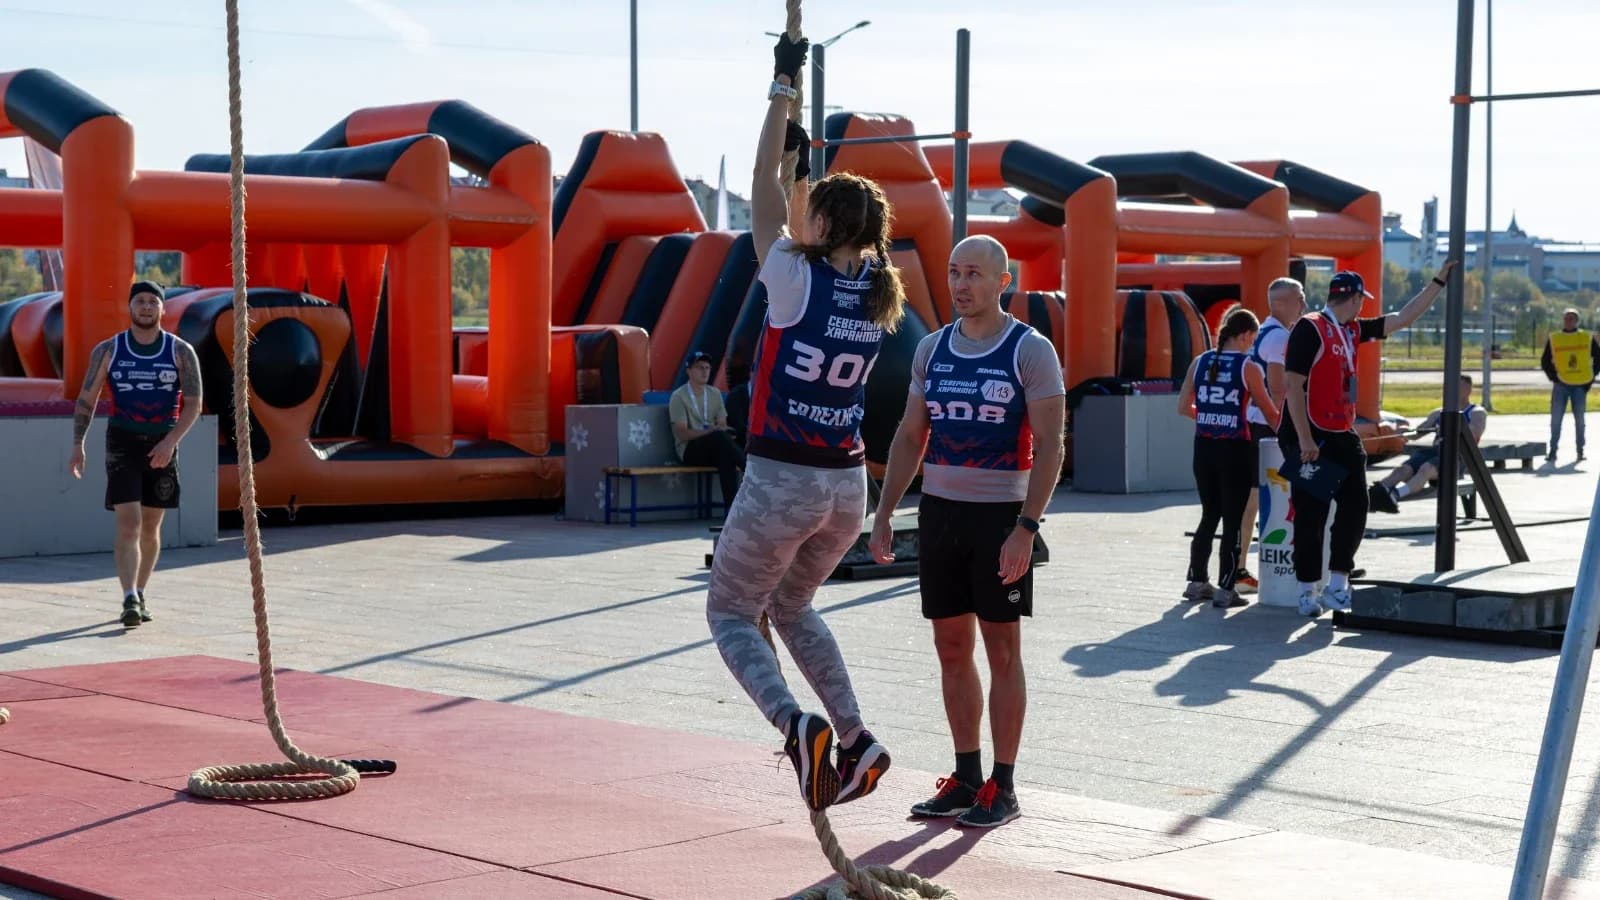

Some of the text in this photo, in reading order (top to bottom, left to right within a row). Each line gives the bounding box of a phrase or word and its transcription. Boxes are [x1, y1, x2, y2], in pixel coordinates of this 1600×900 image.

[785, 340, 880, 388] 30
[939, 379, 978, 388] СЕВЕРНЫЙ
[1197, 385, 1240, 406] 424
[1273, 565, 1296, 577] spo
